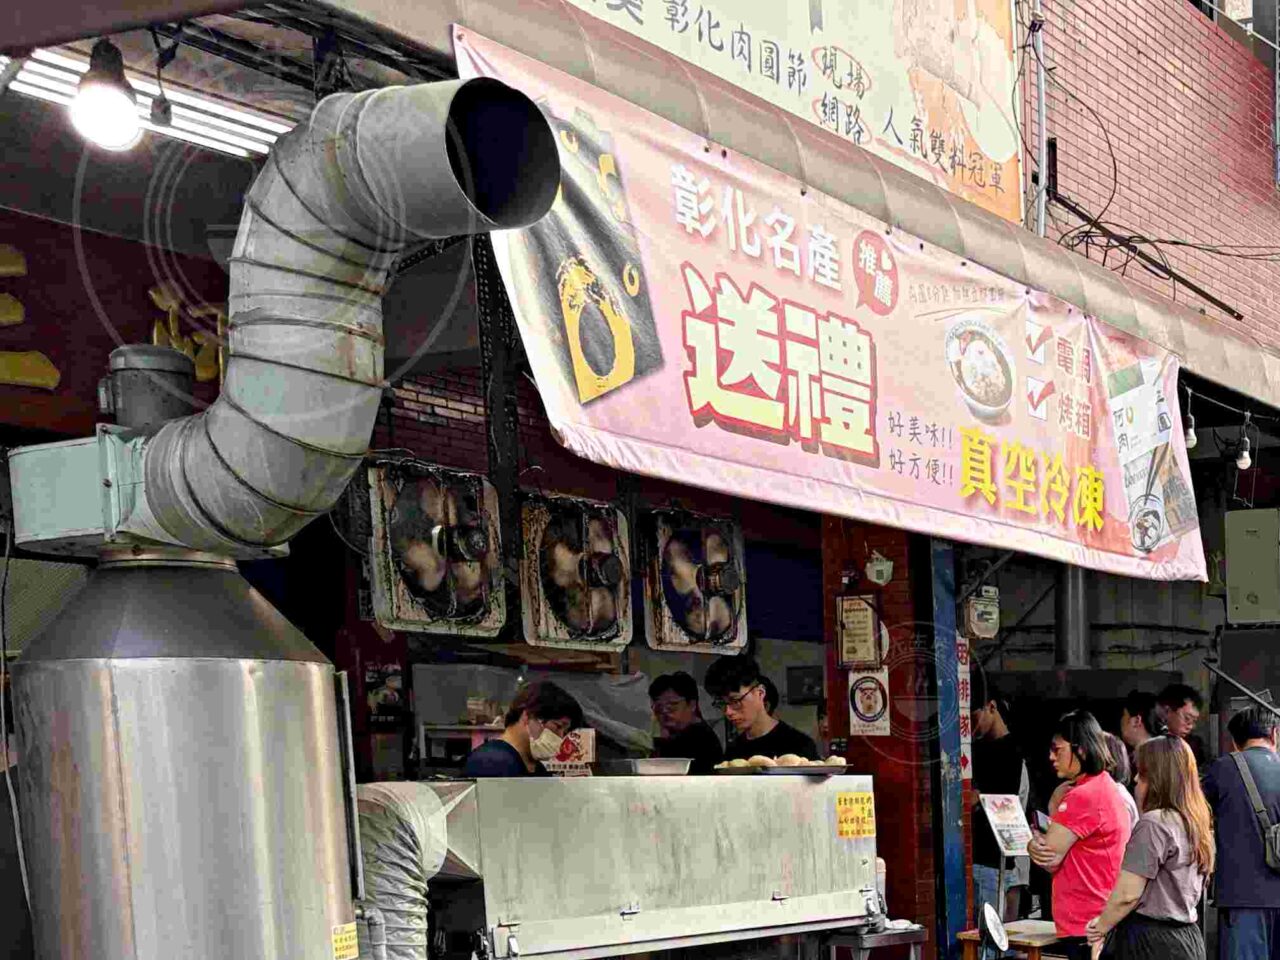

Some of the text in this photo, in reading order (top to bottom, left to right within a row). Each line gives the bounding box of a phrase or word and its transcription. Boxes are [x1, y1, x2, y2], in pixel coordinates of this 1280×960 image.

[822, 46, 865, 99] 現場
[821, 92, 864, 145] 網路
[671, 163, 842, 292] 彰化名產
[682, 262, 880, 467] 送禮
[1057, 392, 1091, 438] 烤箱
[960, 426, 1105, 531] 真空冷凍
